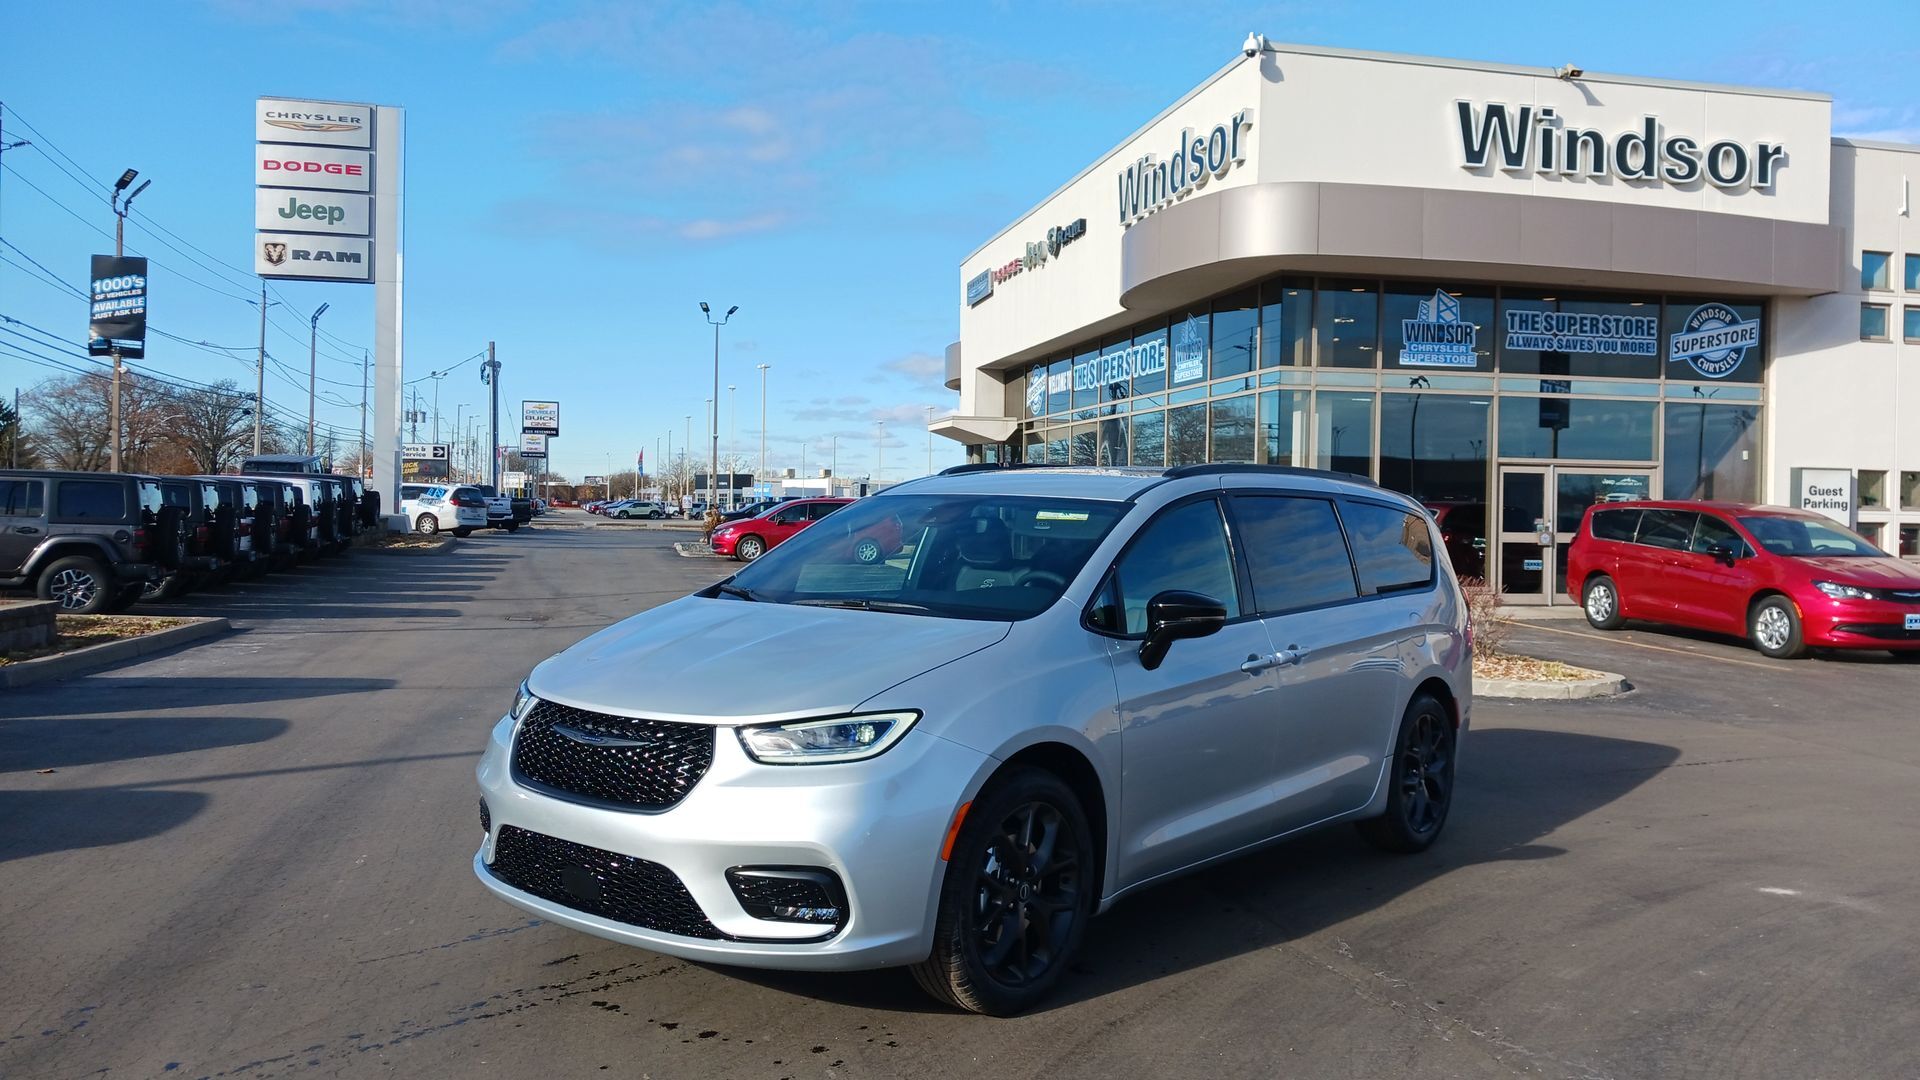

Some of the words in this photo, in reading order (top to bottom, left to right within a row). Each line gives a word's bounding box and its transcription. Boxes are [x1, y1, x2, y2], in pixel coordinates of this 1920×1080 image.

[265, 111, 362, 125] CHRYSLER
[1456, 98, 1785, 188] Windsor
[263, 159, 363, 176] DODGE
[1117, 108, 1253, 225] Windsor
[278, 197, 345, 226] Jeep
[1057, 218, 1087, 245] RAM
[291, 249, 362, 264] RAM
[92, 274, 145, 293] 1000's
[106, 288, 142, 298] VEHICLES
[93, 297, 145, 312] AVAILABLE
[93, 311, 113, 320] JUST
[114, 308, 130, 317] ASK
[1507, 311, 1541, 332] THE
[1542, 313, 1656, 338] SUPERSTORE
[1691, 308, 1732, 329] WINDSOR
[1404, 322, 1474, 345] WINDSOR
[1673, 326, 1756, 355] SUPERSTORE
[1411, 343, 1467, 353] CHRYSLER
[1507, 335, 1554, 350] ALWAYS
[1556, 337, 1594, 352] SAVES
[1596, 339, 1618, 353] YOU
[1619, 340, 1656, 354] MORE!
[1074, 365, 1088, 390] THE
[1088, 338, 1165, 389] SUPERSTORE
[1402, 353, 1475, 364] SUPERSTORE
[1697, 351, 1739, 373] CHRYSLER
[1808, 485, 1843, 497] Guest
[1803, 498, 1849, 512] Parking
